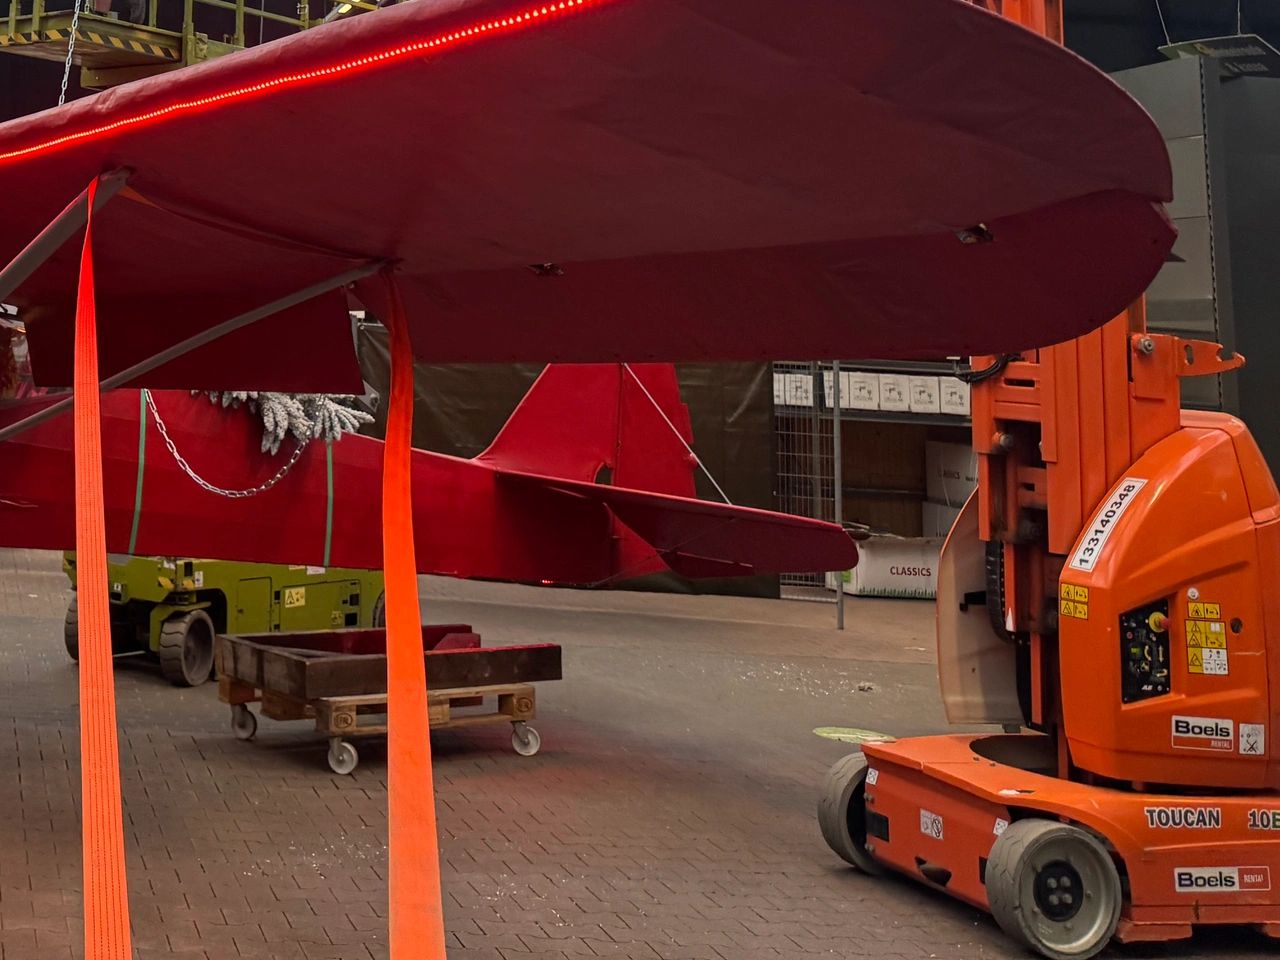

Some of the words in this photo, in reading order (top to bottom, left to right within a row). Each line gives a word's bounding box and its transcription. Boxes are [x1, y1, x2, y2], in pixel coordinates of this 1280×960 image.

[1079, 484, 1136, 566] 133140348
[889, 566, 932, 577] CLASSICS
[1174, 719, 1231, 738] Boels
[1144, 807, 1221, 828] TOUCAN
[1177, 871, 1236, 888] Boels
